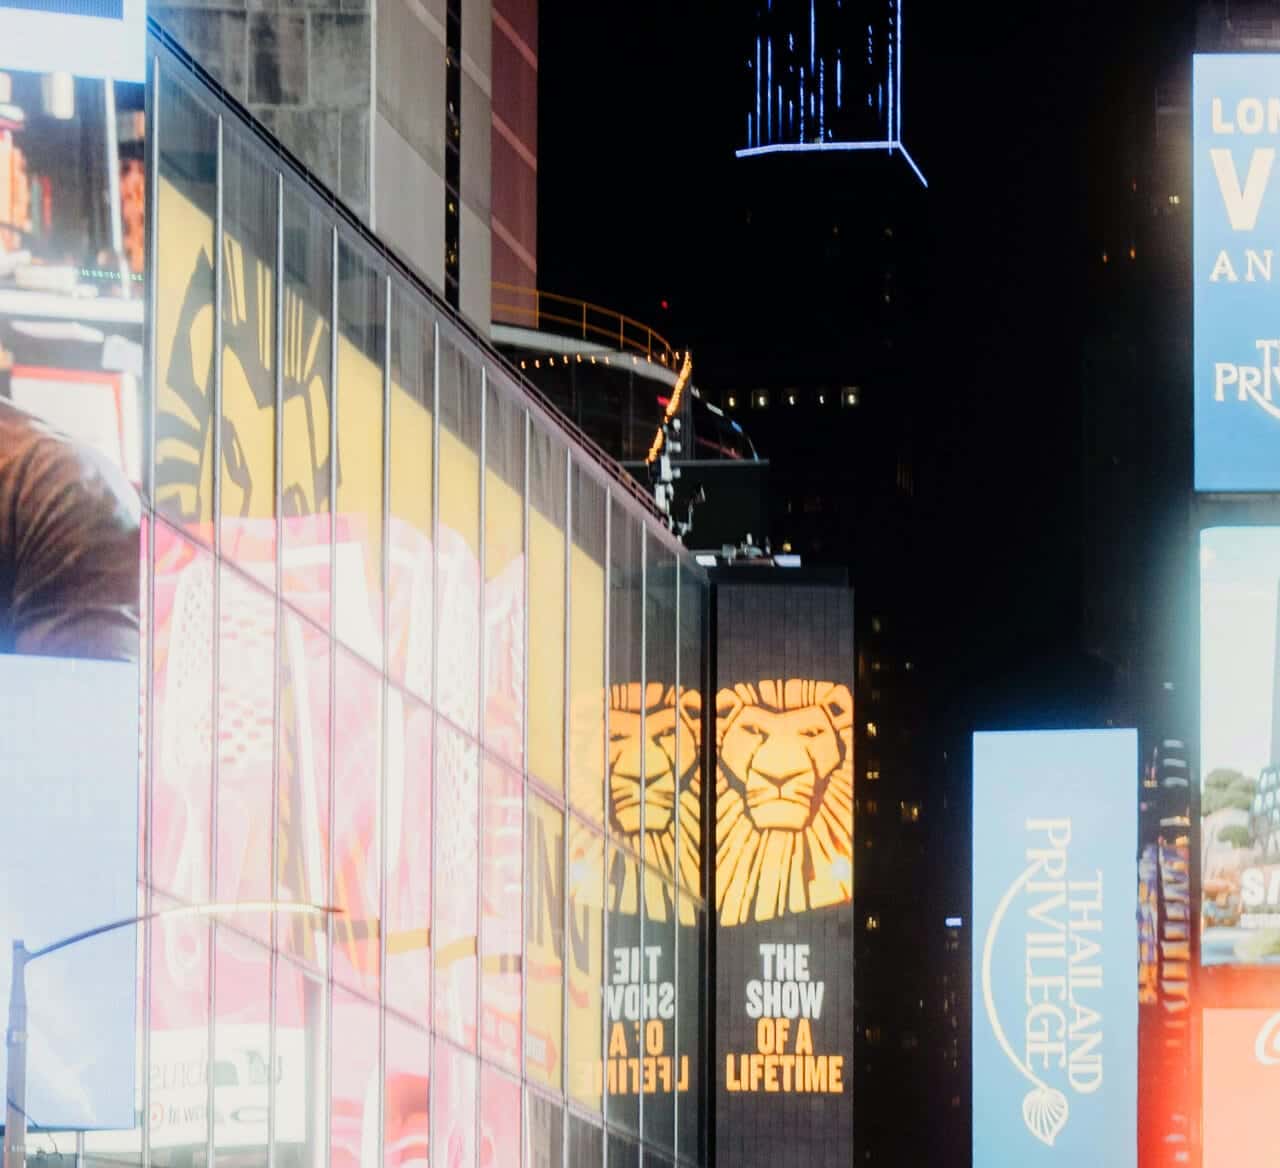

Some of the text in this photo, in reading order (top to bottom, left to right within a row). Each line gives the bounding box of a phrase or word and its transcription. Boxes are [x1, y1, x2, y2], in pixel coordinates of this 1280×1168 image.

[759, 944, 811, 982] THE
[1025, 817, 1073, 1072] PRIVILEGE
[745, 981, 825, 1020] SHOW
[1068, 870, 1103, 1094] THAILAND
[756, 1018, 813, 1056] OF A
[726, 1054, 844, 1093] LIFETIME
